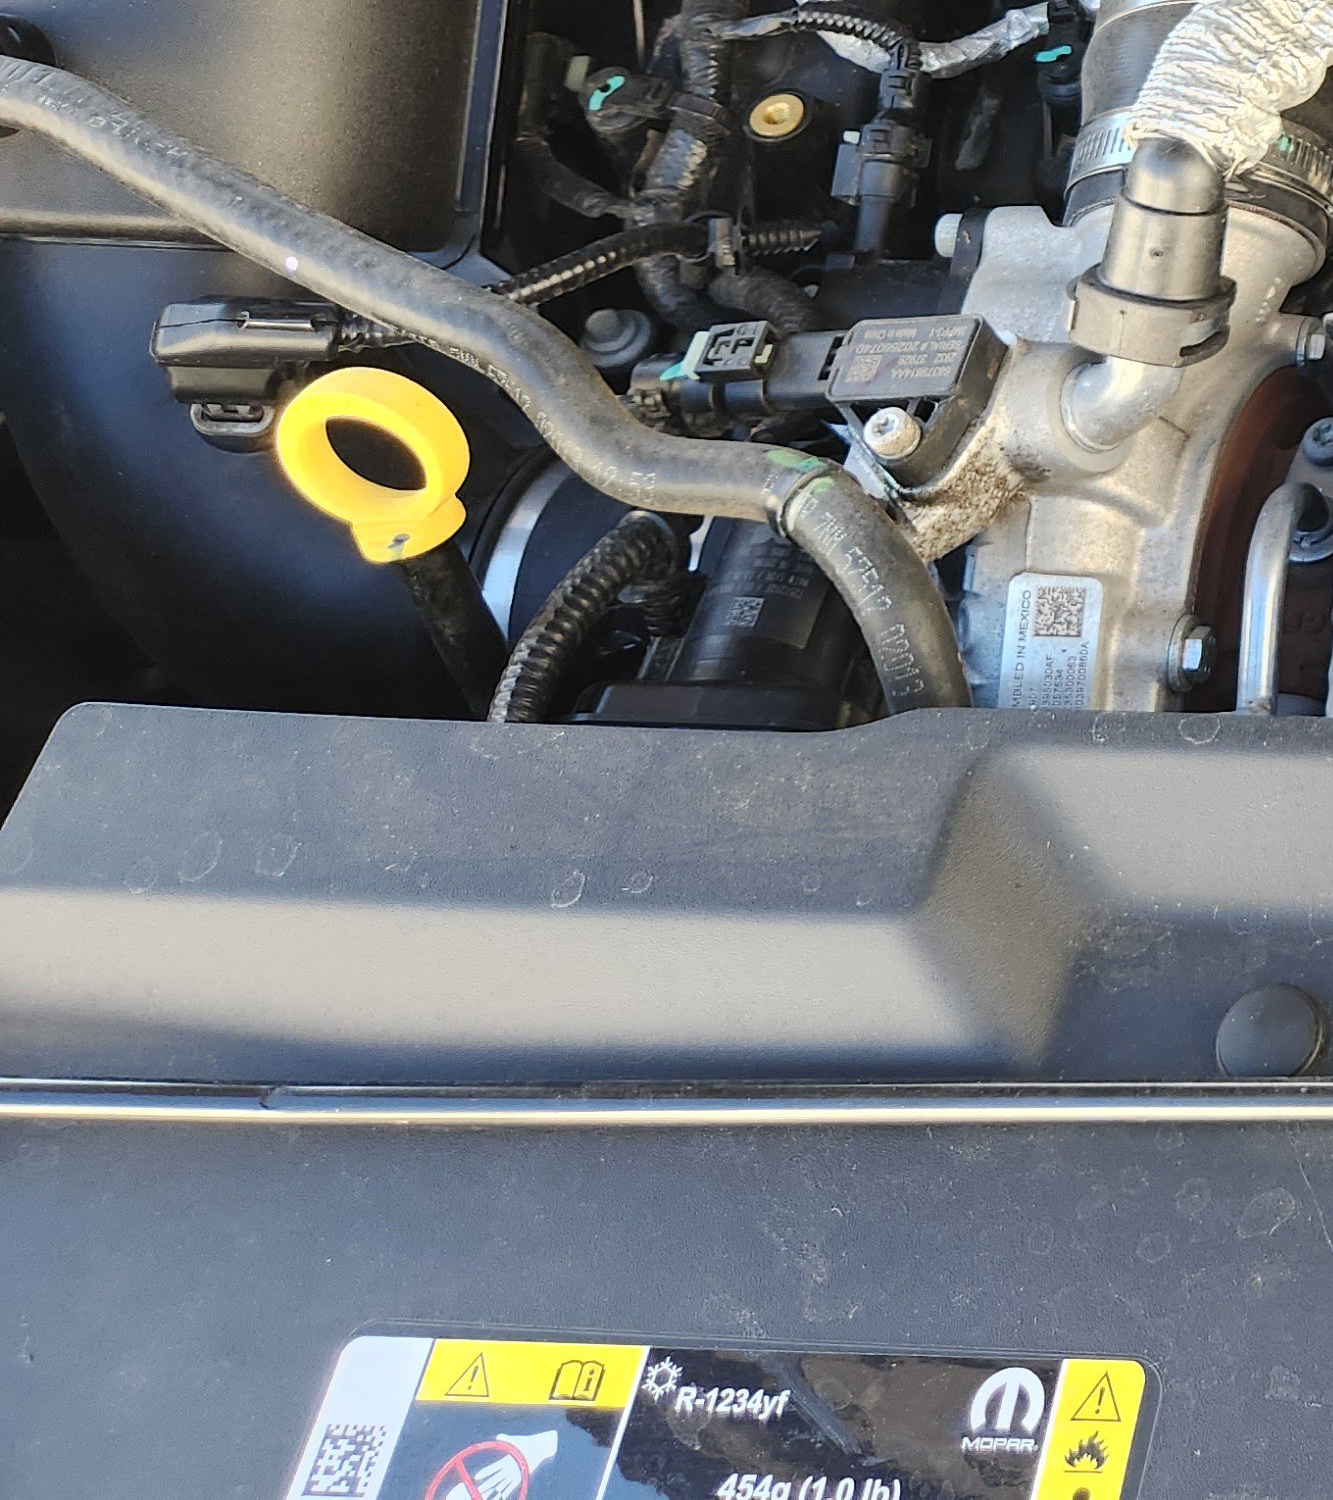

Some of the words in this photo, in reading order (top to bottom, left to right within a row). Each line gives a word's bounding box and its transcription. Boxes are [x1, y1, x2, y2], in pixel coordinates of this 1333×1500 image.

[1018, 590, 1032, 642] MEXICO
[674, 1385, 791, 1419] R-1234yf
[861, 1477, 901, 1500] lb)
